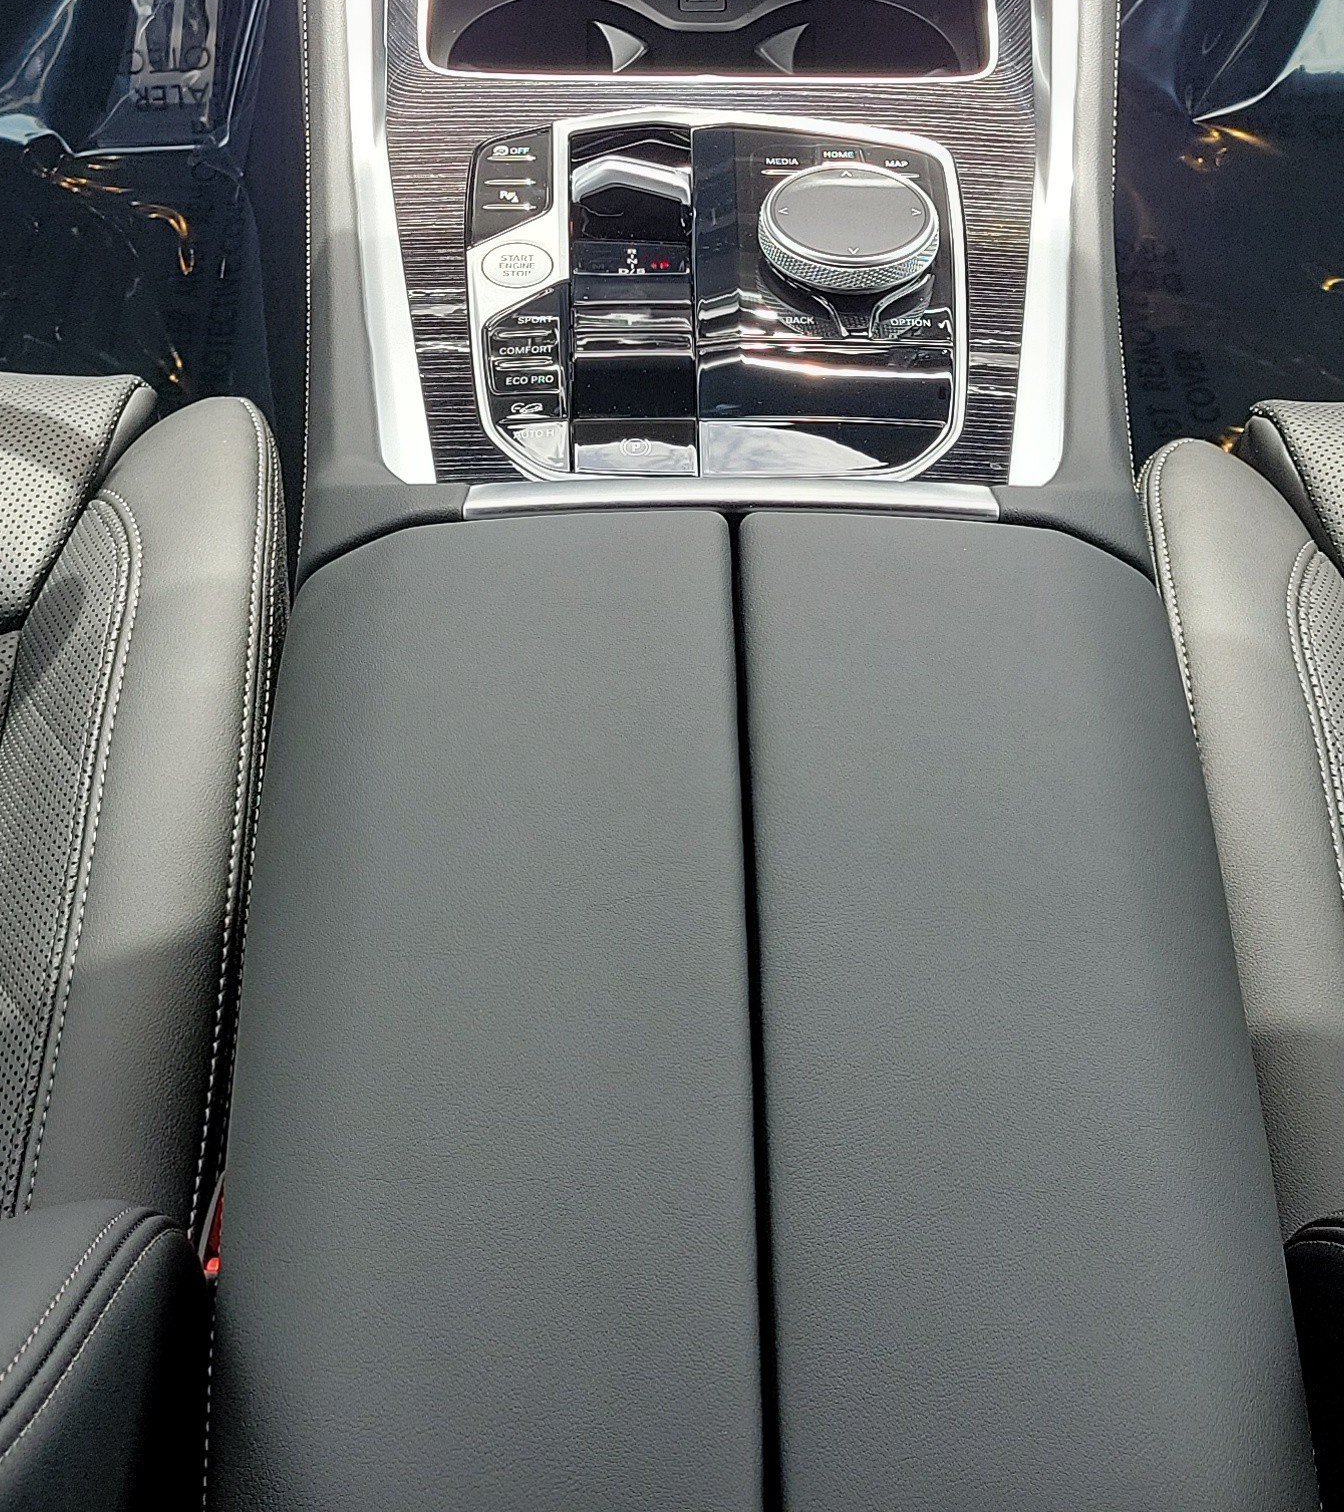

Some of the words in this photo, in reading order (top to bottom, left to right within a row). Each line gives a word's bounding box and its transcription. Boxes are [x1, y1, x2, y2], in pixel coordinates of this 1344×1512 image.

[509, 147, 531, 155] OFF
[822, 151, 855, 159] HOME
[765, 157, 799, 166] MEDIA
[884, 160, 909, 168] MAP
[500, 254, 535, 262] START
[517, 316, 553, 325] SPORT
[785, 316, 815, 325] BACK
[890, 318, 931, 327] OPTION
[499, 345, 553, 356] COMFORT
[505, 376, 528, 386] ECO
[531, 375, 554, 384] PRO
